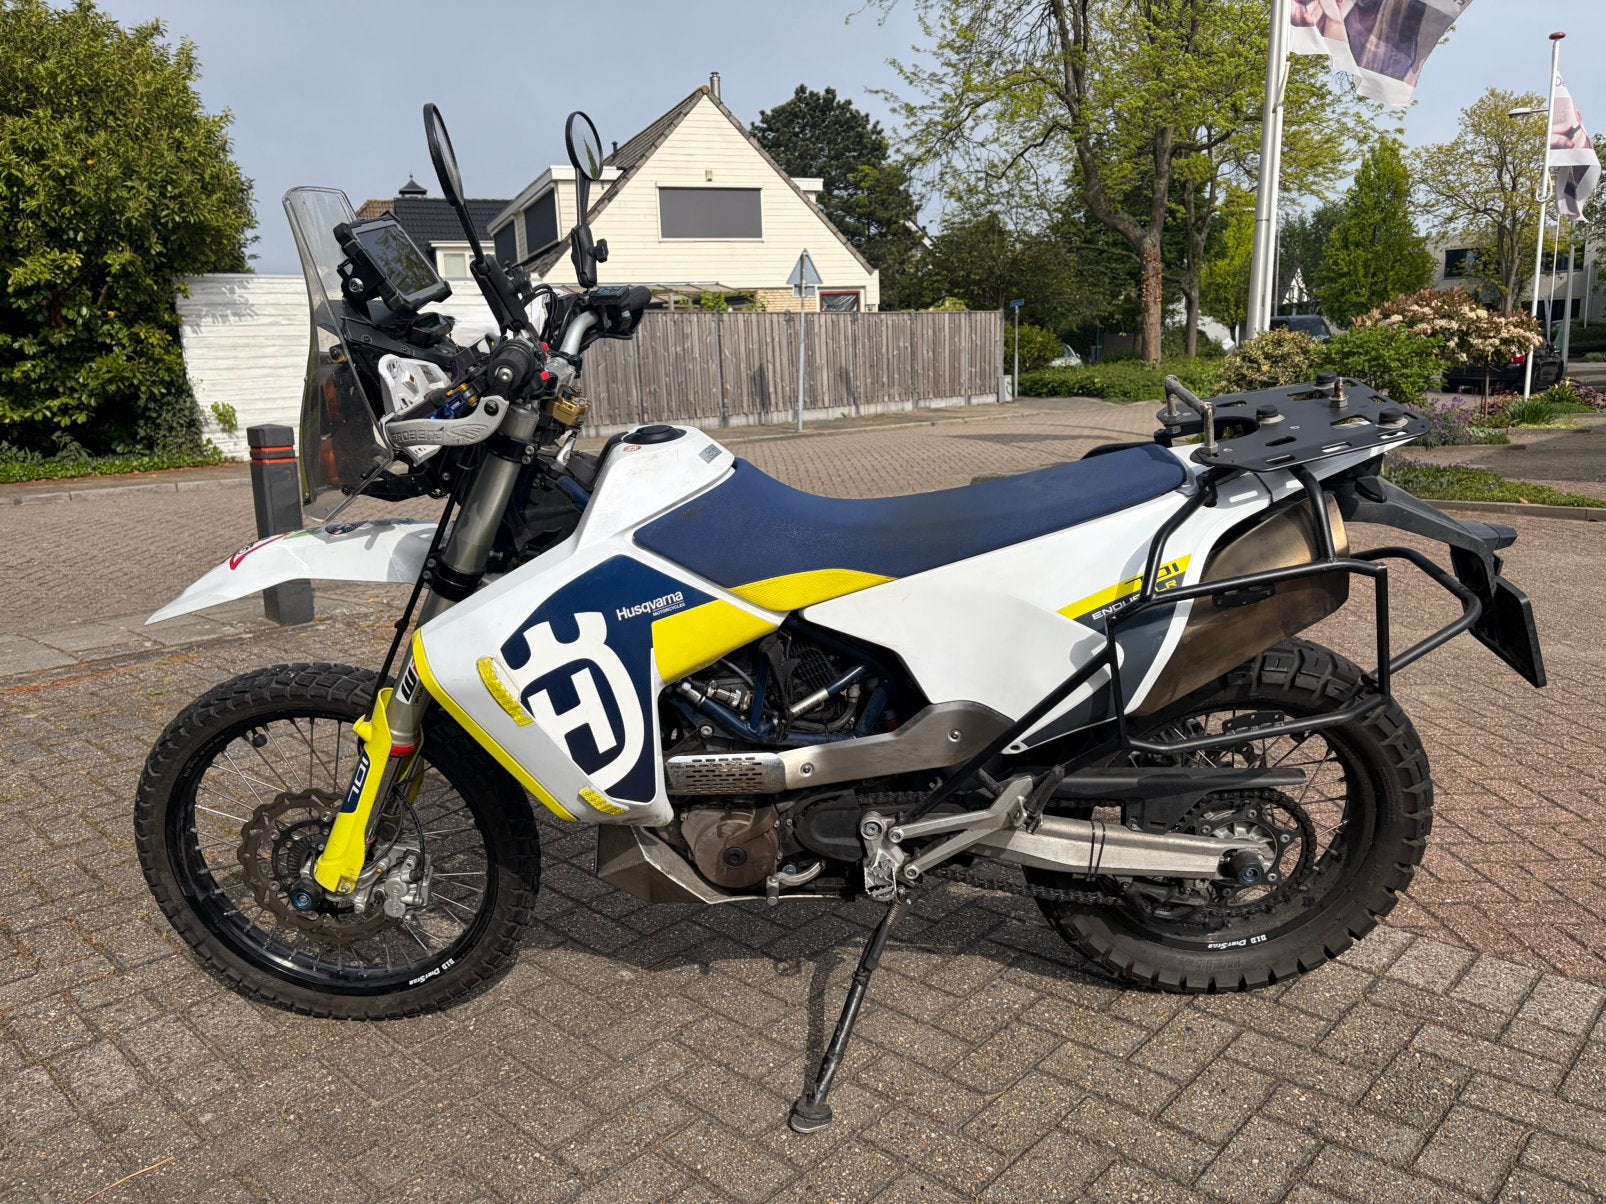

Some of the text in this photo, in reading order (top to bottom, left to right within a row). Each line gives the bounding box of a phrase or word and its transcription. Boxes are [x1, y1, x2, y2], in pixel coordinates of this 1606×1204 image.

[616, 591, 684, 621] Husqvarna
[652, 602, 686, 617] MOTORCYCLES
[1091, 593, 1142, 620] ENDUR
[347, 756, 369, 803] 701
